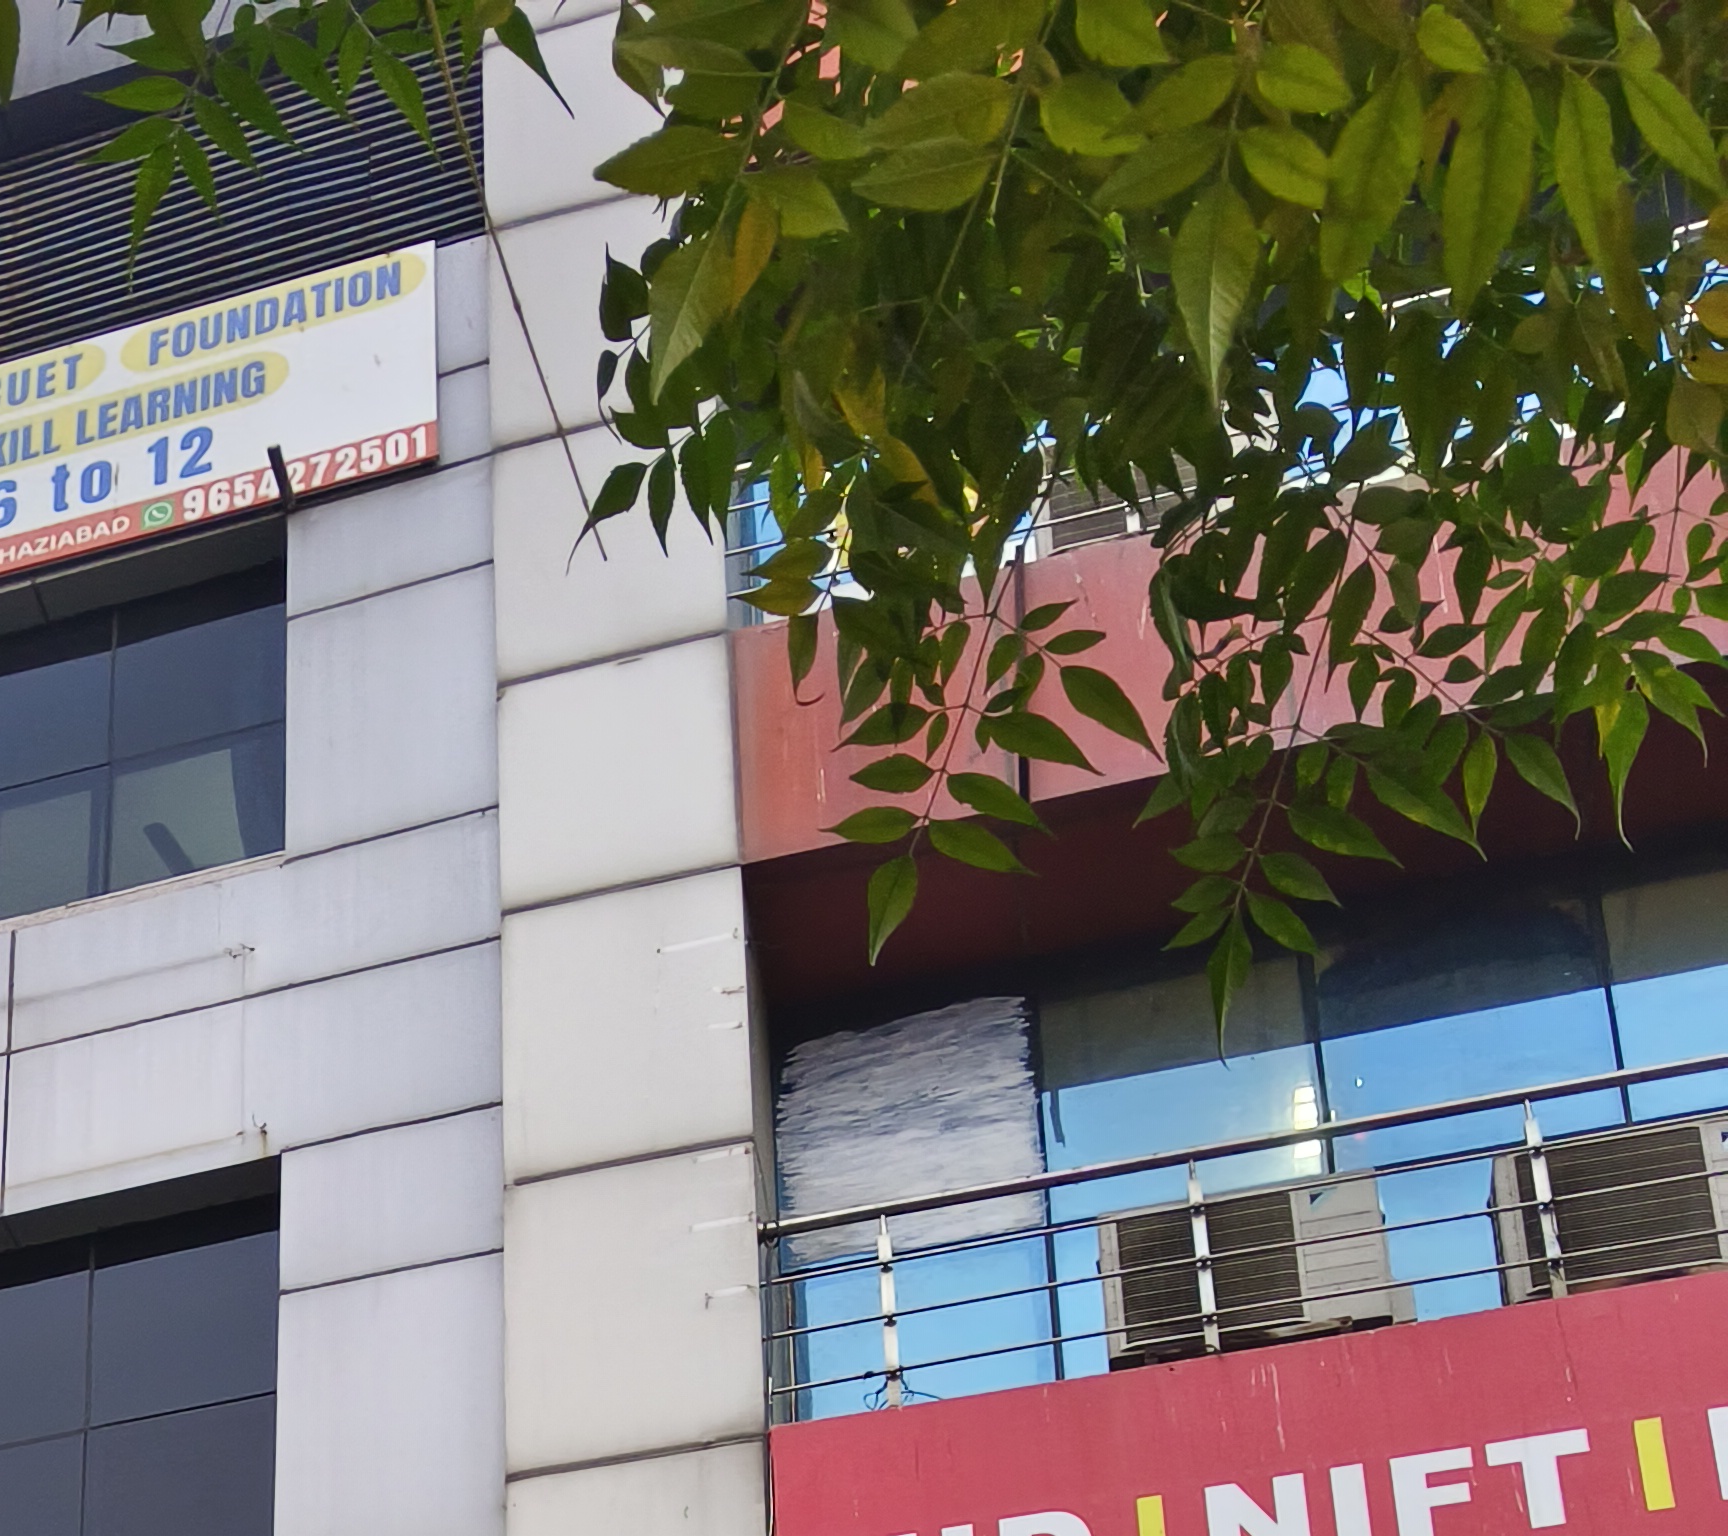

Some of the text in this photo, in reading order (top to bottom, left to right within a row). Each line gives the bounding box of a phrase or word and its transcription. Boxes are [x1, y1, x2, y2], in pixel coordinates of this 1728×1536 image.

[148, 261, 402, 366] FOUNDATION
[75, 360, 268, 446] LEARNING
[49, 459, 114, 513] to
[147, 426, 214, 487] 12
[182, 425, 429, 522] 9654272501
